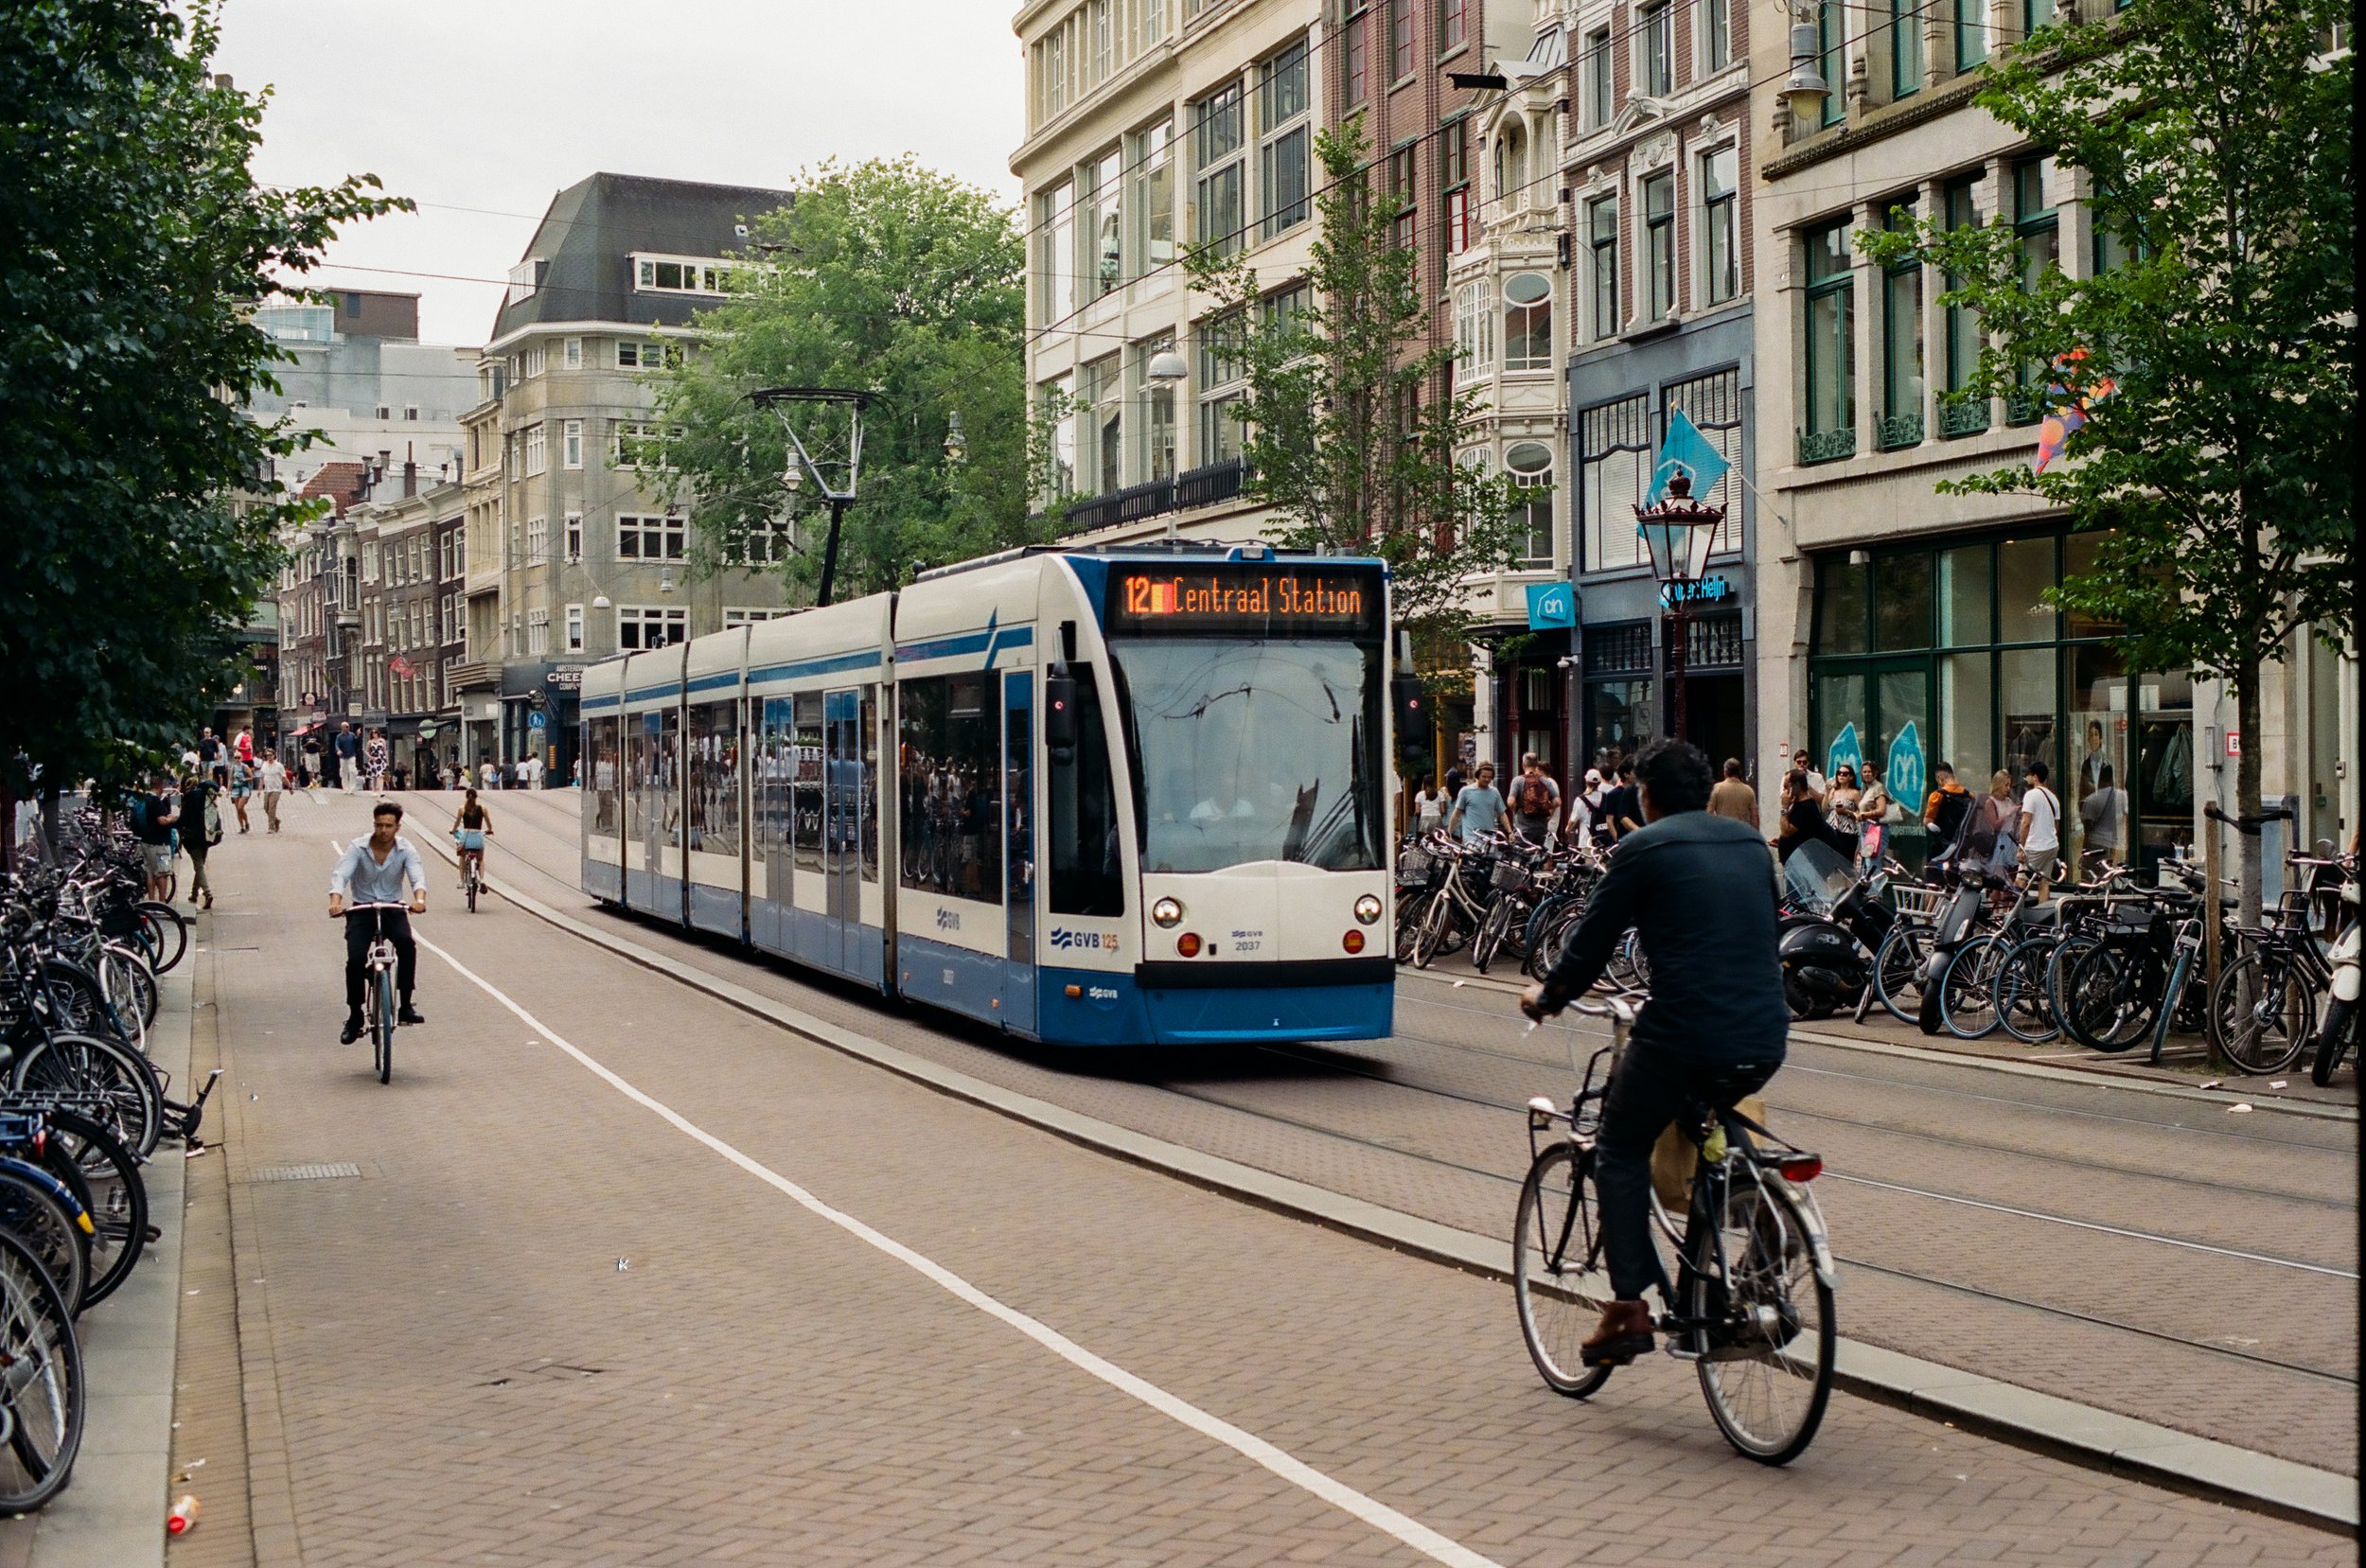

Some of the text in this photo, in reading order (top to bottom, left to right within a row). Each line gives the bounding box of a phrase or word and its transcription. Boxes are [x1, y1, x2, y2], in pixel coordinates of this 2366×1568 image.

[1126, 576, 1361, 613] 12 Centraal Station
[1701, 575, 1725, 602] Heijn
[547, 673, 581, 682] CHEE
[948, 911, 961, 931] GVB
[1074, 931, 1119, 949] GVB 125
[1234, 941, 1261, 951] 2037
[1103, 988, 1119, 999] GVB
